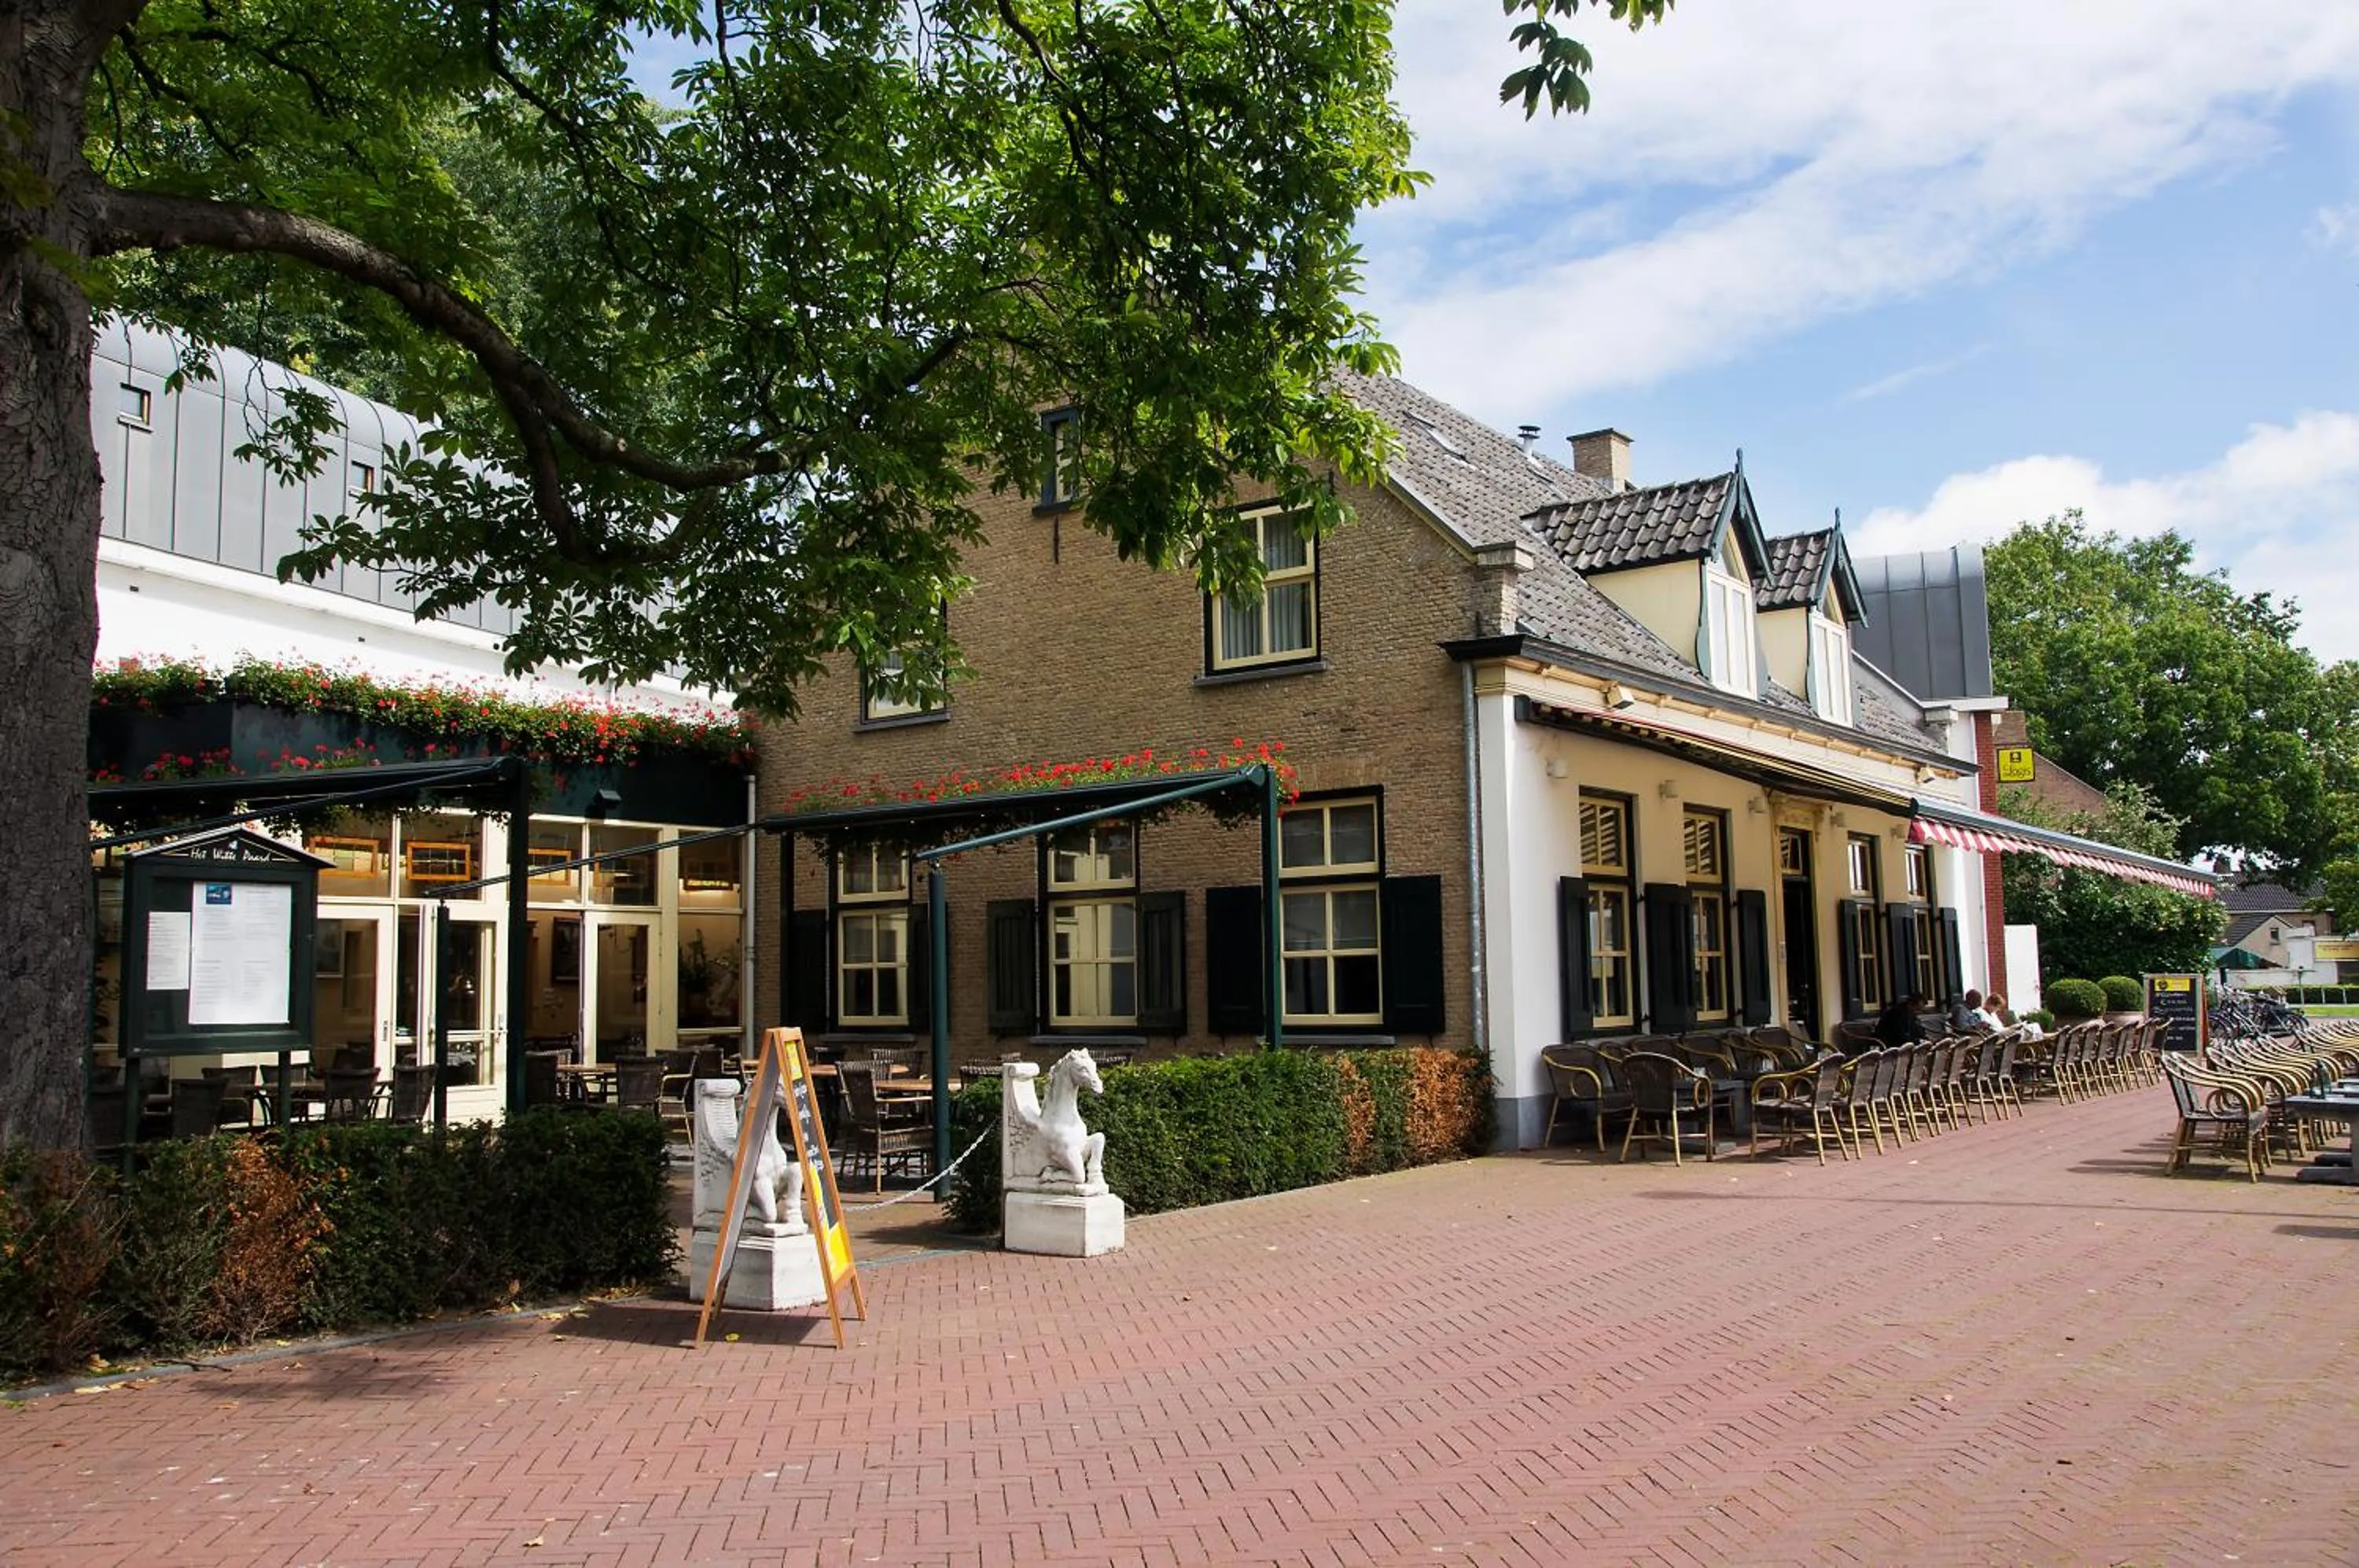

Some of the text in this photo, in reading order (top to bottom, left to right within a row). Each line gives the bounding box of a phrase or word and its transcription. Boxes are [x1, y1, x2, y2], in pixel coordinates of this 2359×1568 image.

[190, 848, 270, 862] Het Witte Paard
